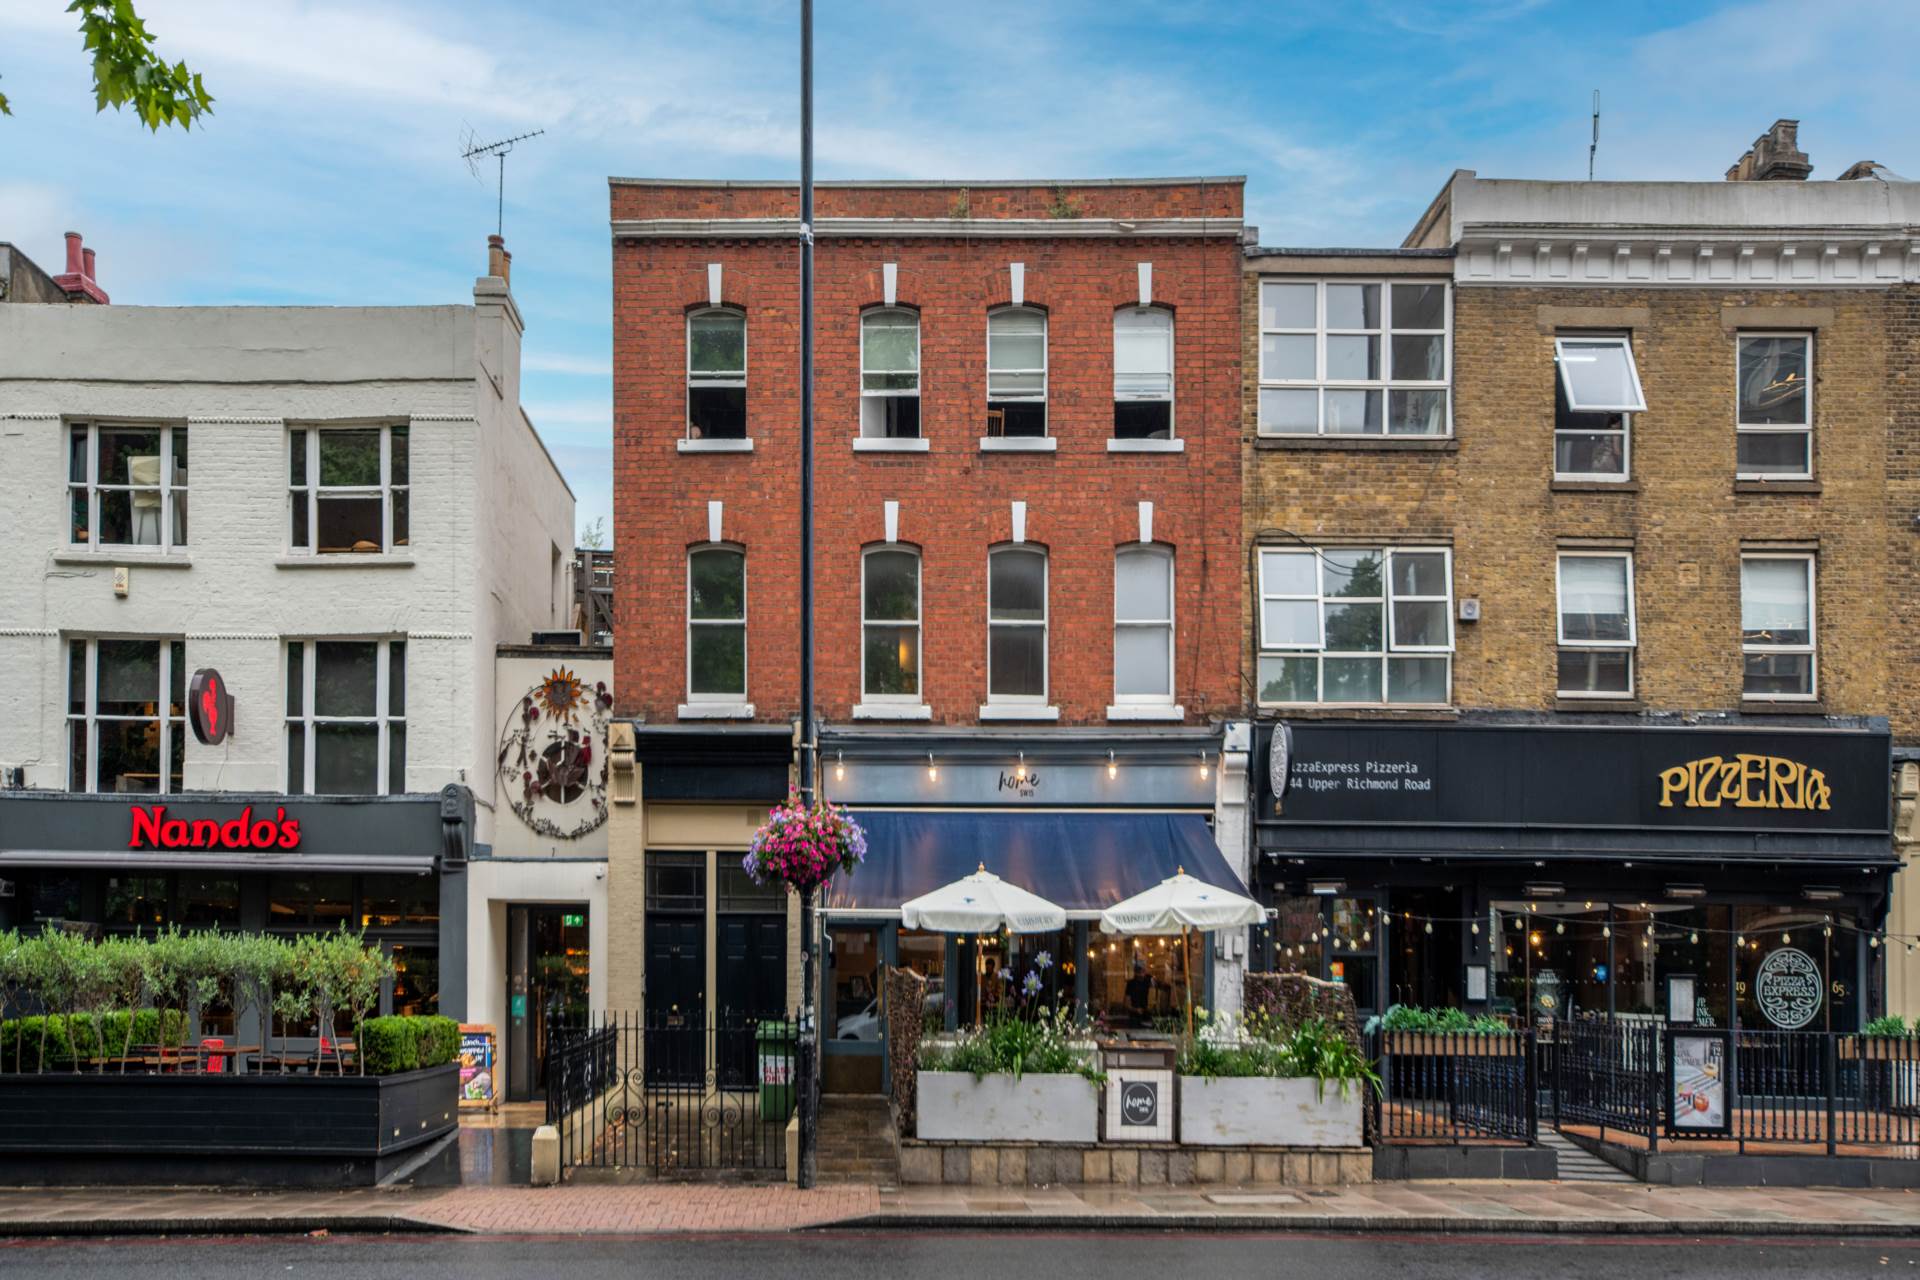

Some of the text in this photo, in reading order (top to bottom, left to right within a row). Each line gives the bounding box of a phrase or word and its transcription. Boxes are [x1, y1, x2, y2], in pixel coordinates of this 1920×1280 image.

[1291, 761, 1418, 774] zzaExpress Pizzeria
[1289, 777, 1431, 791] 44 Upper Richmond Road
[1658, 753, 1832, 810] PIZZERIA
[127, 805, 300, 849] Nando's
[1772, 975, 1806, 986] PIZZA
[1763, 986, 1815, 997] EXPRESS
[1126, 1094, 1153, 1109] home
